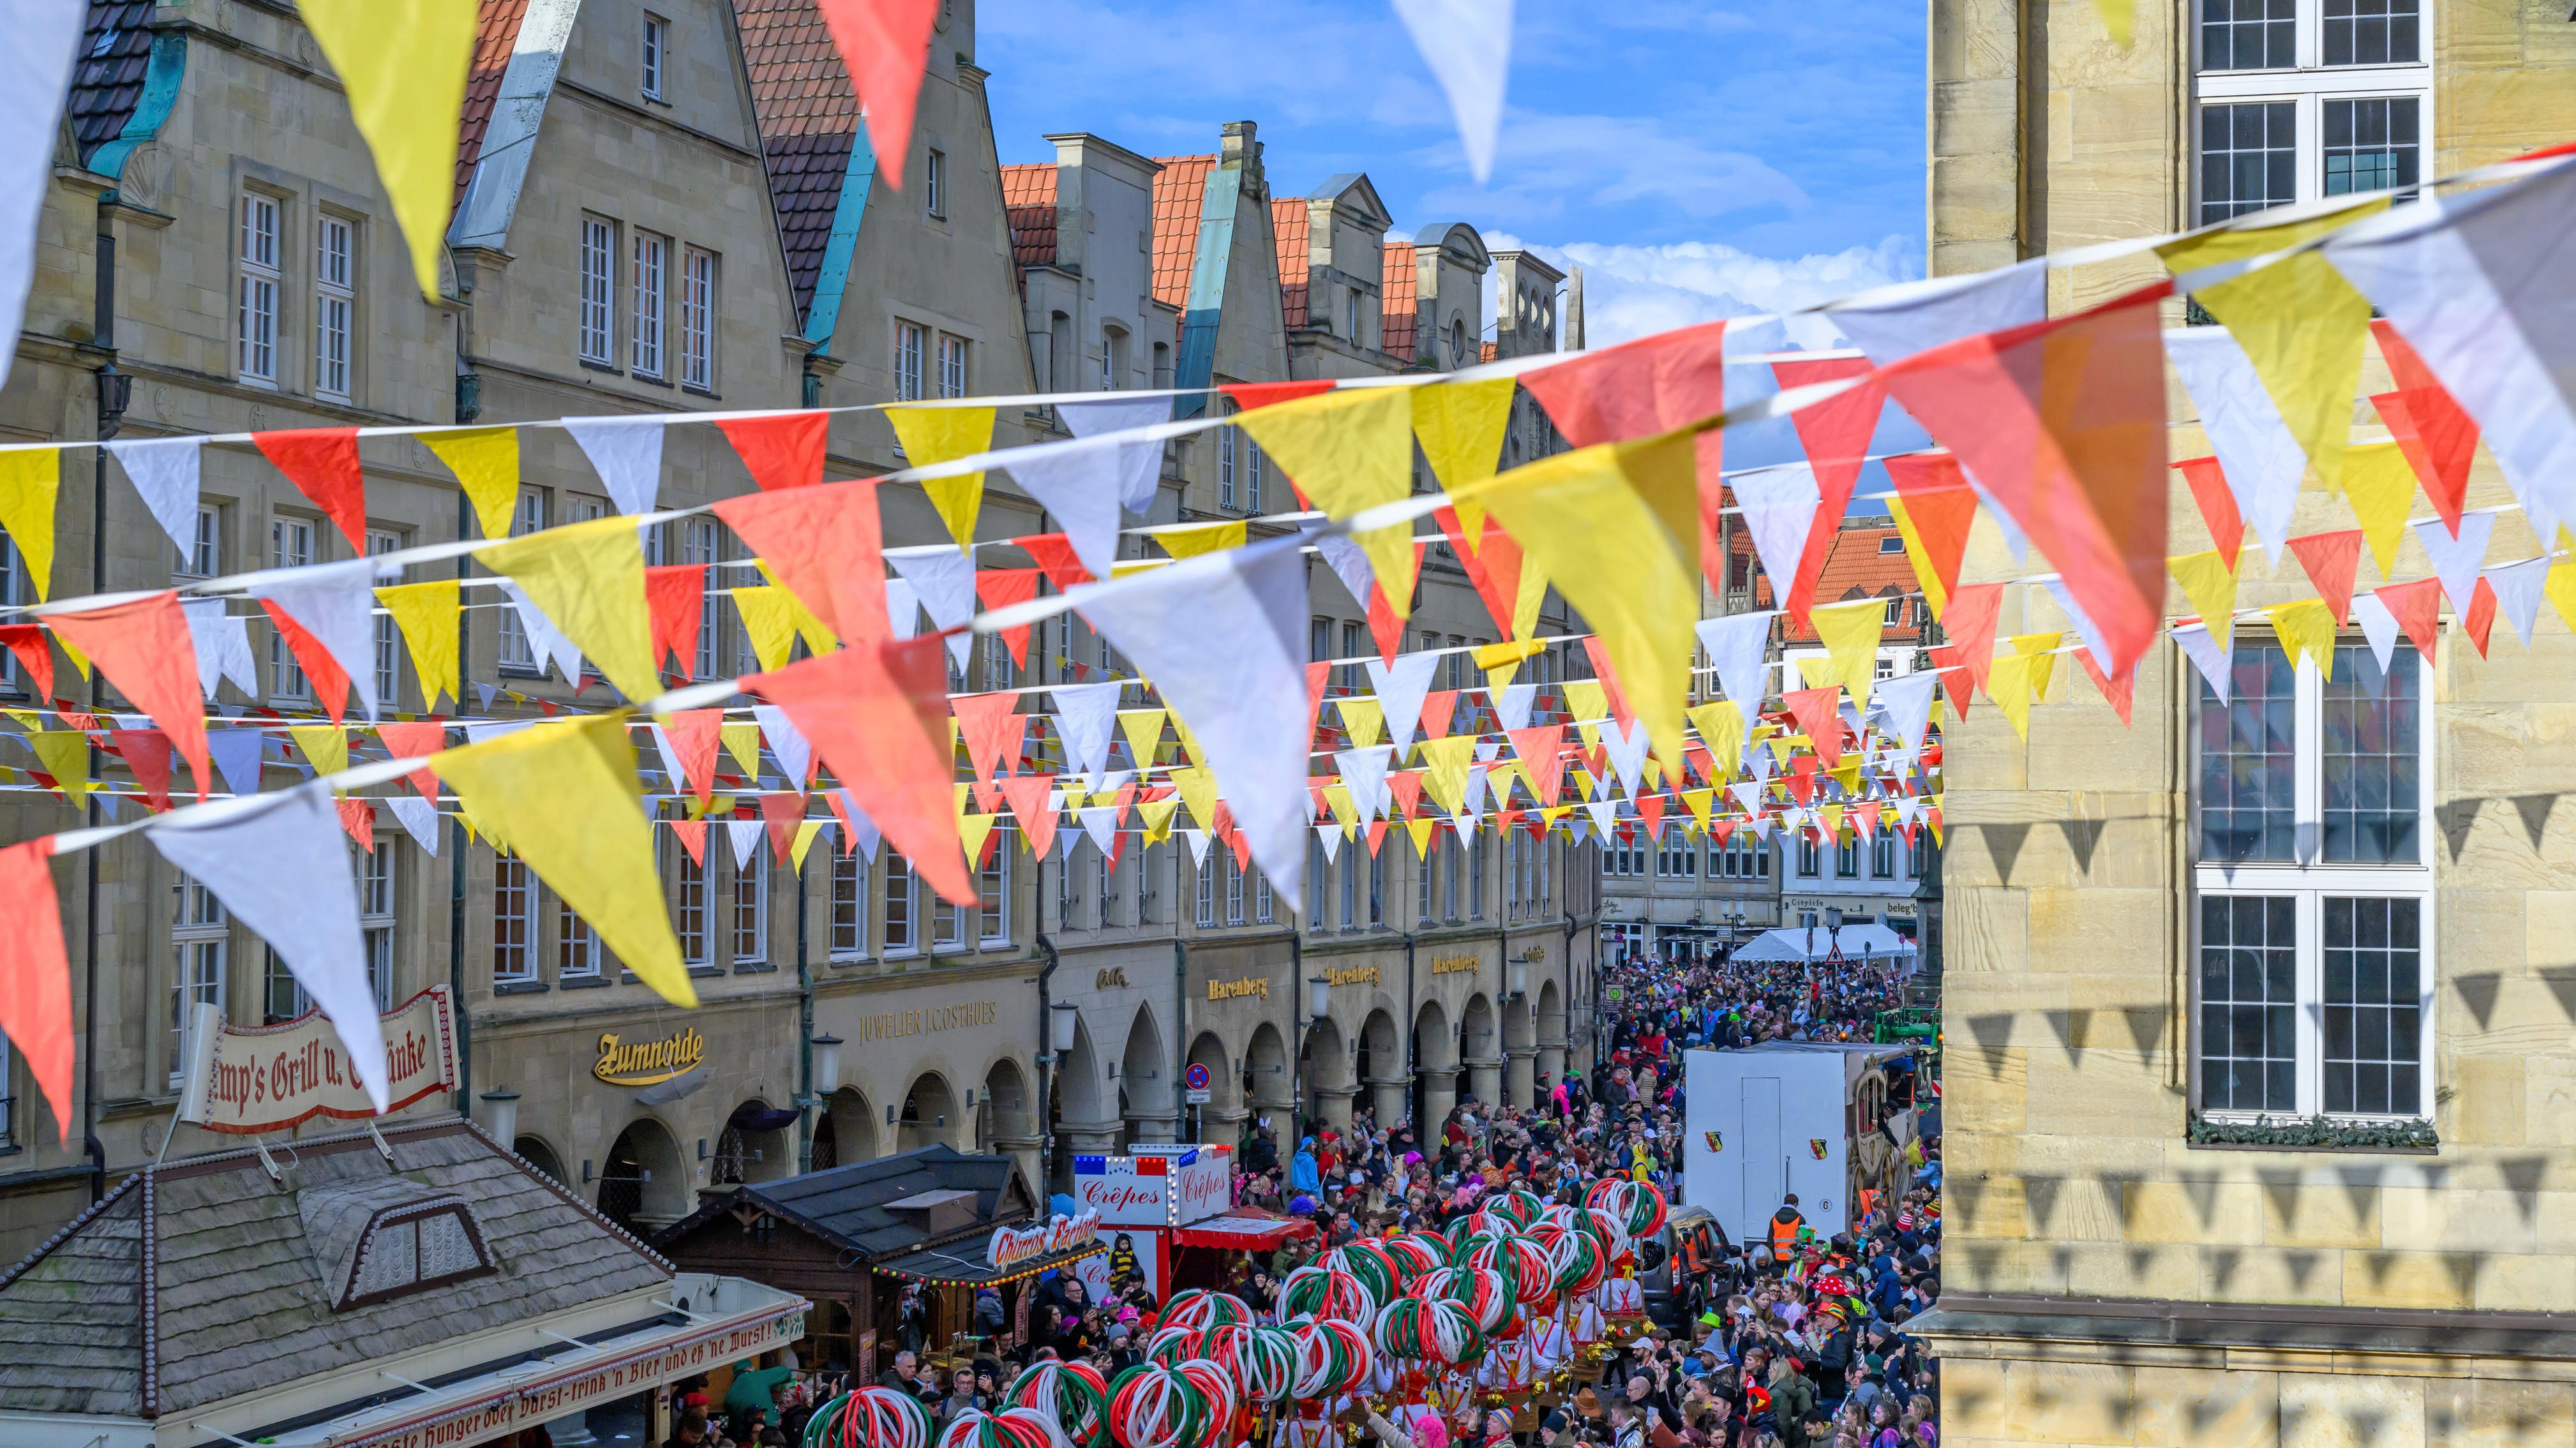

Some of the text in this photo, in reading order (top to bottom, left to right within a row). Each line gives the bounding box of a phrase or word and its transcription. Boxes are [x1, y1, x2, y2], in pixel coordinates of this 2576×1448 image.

[1325, 965, 1379, 987] Harenberg
[1432, 955, 1479, 974] Harenberg
[1207, 976, 1269, 1000] Harenberg
[860, 1010, 921, 1046] JUWELIER
[595, 1027, 705, 1080] Zumnorde
[271, 1037, 319, 1101] Grill
[324, 1047, 342, 1086] u.
[1082, 1181, 1160, 1212] Crêpes
[1183, 1169, 1225, 1209] Crêpes
[1823, 1201, 1829, 1210] 6
[995, 1214, 1102, 1271] Churros Factory
[1622, 1265, 1635, 1281] 70
[1534, 1317, 1548, 1335] 70
[629, 1357, 660, 1383] Bier
[665, 1348, 687, 1372] und
[691, 1347, 704, 1365] eß
[708, 1339, 724, 1358] 'ne
[729, 1321, 772, 1353] Wurst!
[1425, 1389, 1441, 1408] 70
[1252, 1417, 1263, 1440] 70
